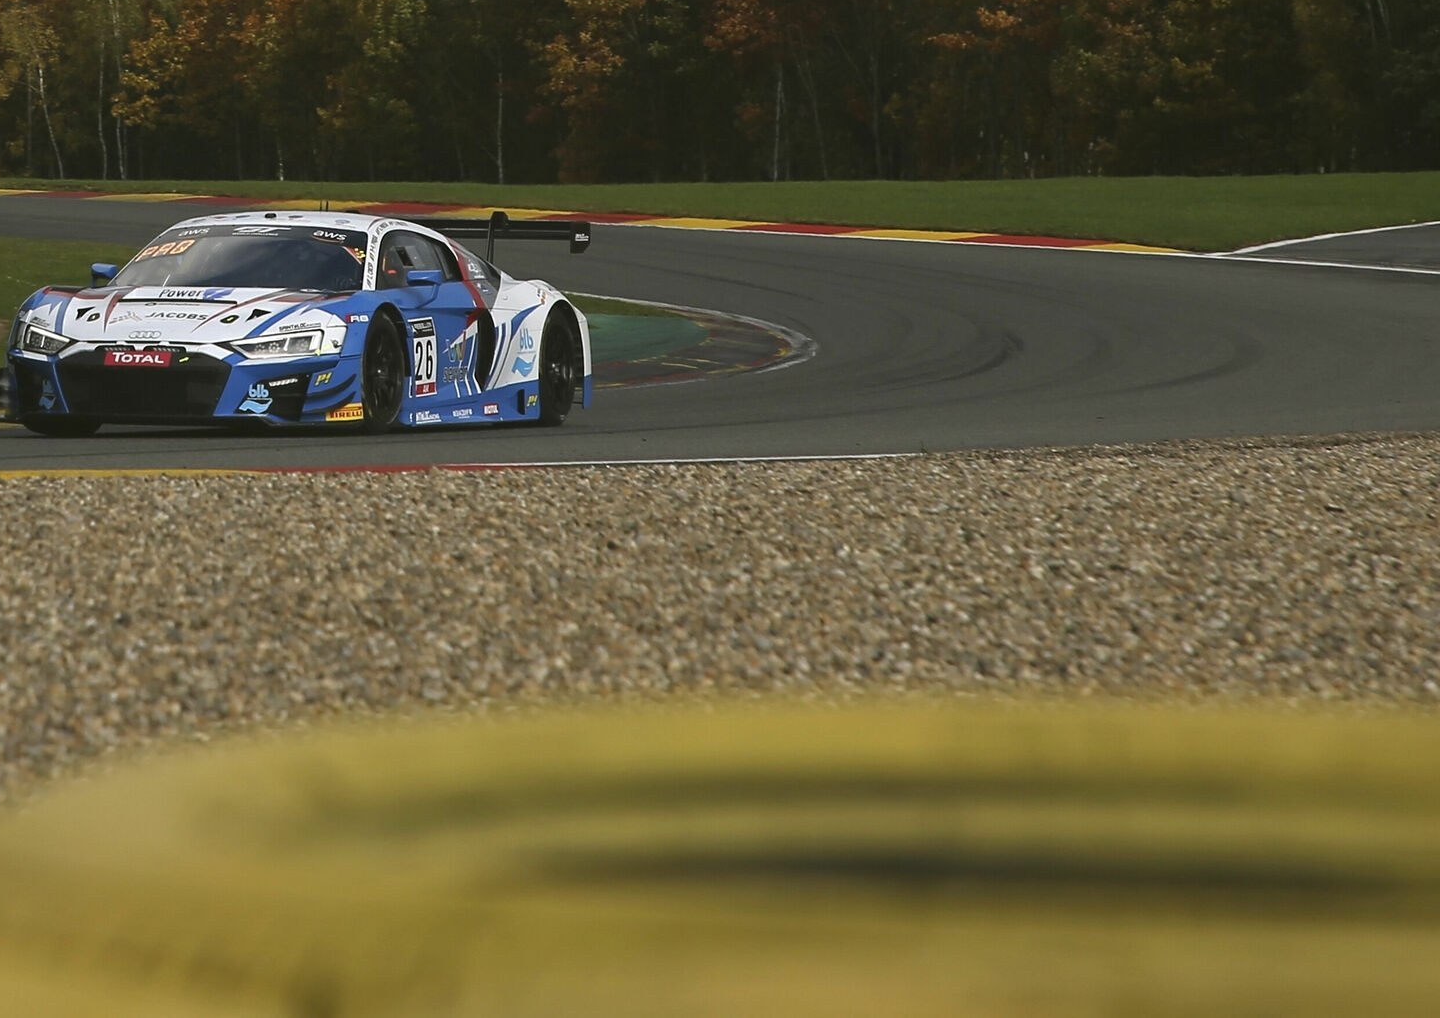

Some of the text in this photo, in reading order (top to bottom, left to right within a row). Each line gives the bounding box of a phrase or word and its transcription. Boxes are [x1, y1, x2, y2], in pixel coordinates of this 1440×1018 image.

[178, 227, 210, 237] aws
[313, 229, 347, 242] aws
[160, 288, 203, 298] Power
[145, 312, 209, 321] JACOBS
[112, 352, 164, 364] TOTAL
[415, 340, 433, 381] 26
[248, 383, 269, 398] blb
